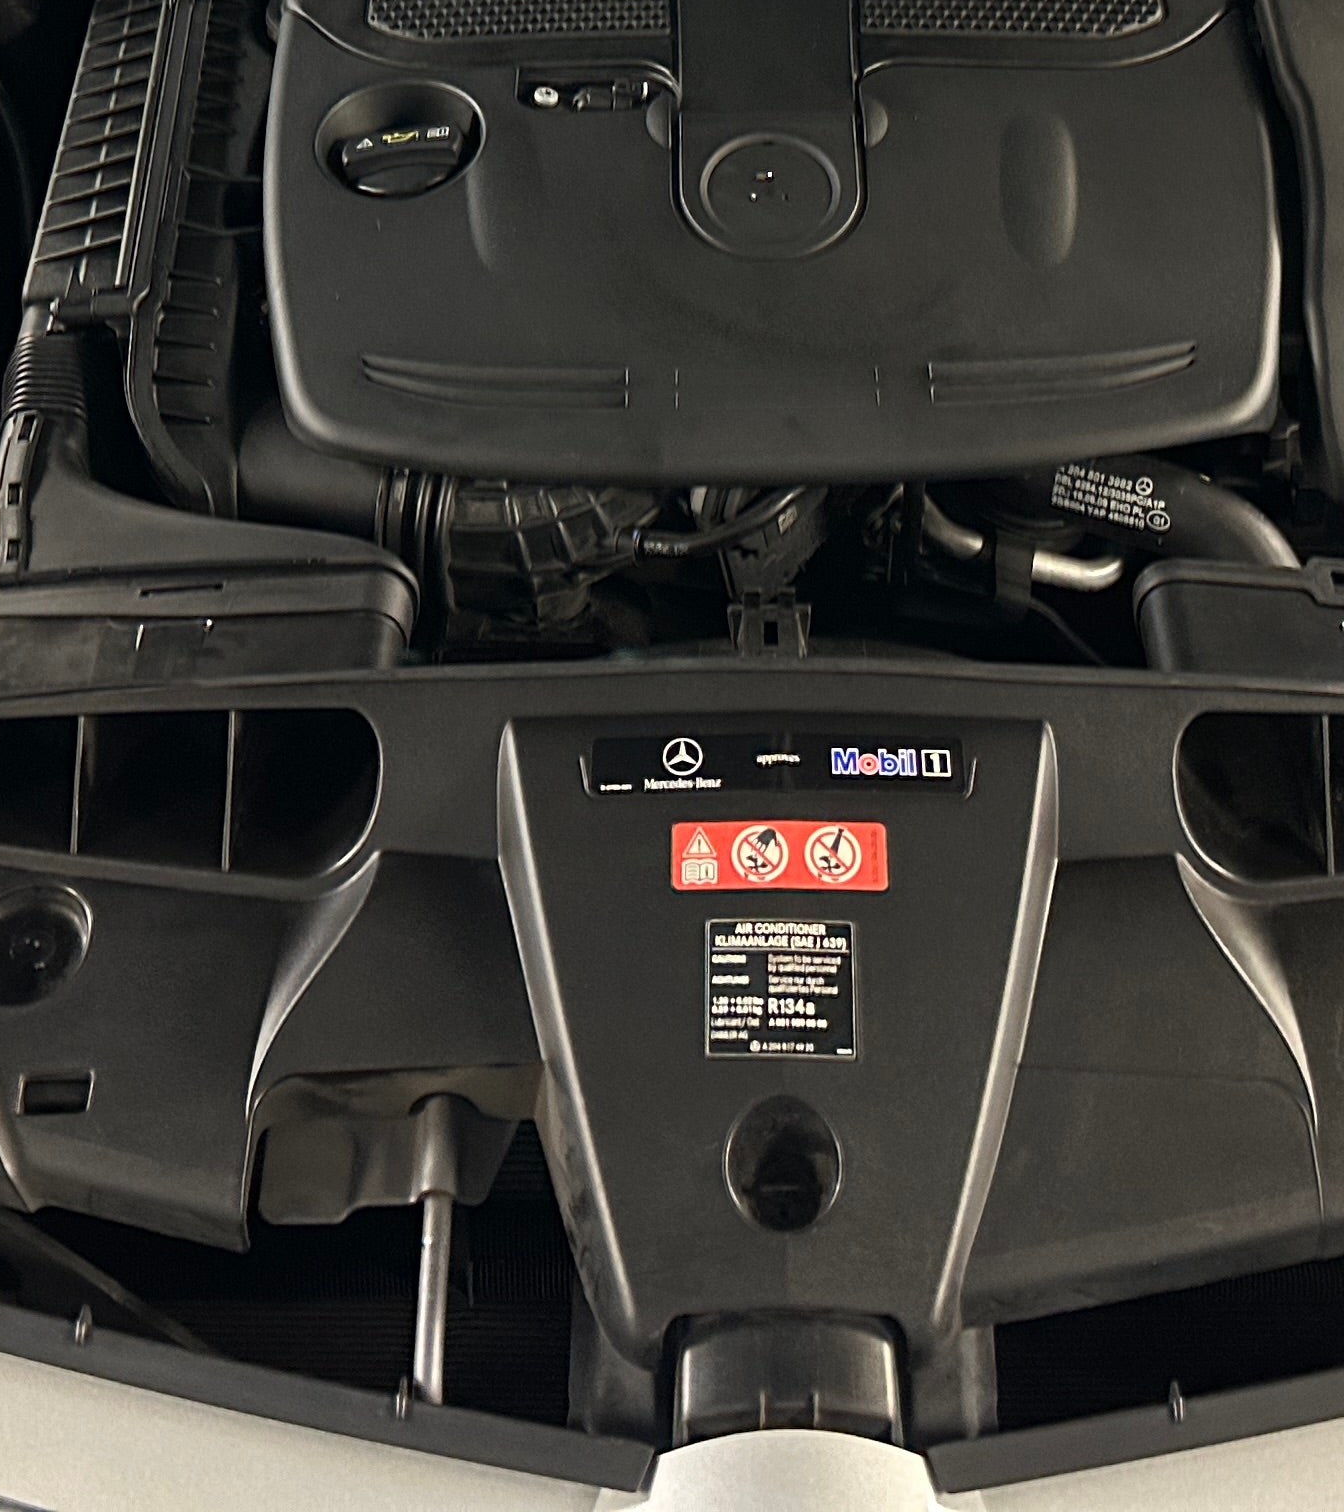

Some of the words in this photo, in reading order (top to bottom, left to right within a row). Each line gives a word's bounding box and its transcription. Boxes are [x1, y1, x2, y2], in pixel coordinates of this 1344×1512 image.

[756, 753, 801, 766] approves
[831, 747, 917, 776] Mobil
[644, 777, 722, 790] Mercedes-Benz
[734, 922, 753, 935] AIR
[754, 923, 826, 936] CONDITIONER
[714, 935, 788, 947] KLIMAANLAGE
[790, 936, 814, 949] (SAE
[822, 937, 847, 950] 639)
[767, 998, 816, 1016] R134a
